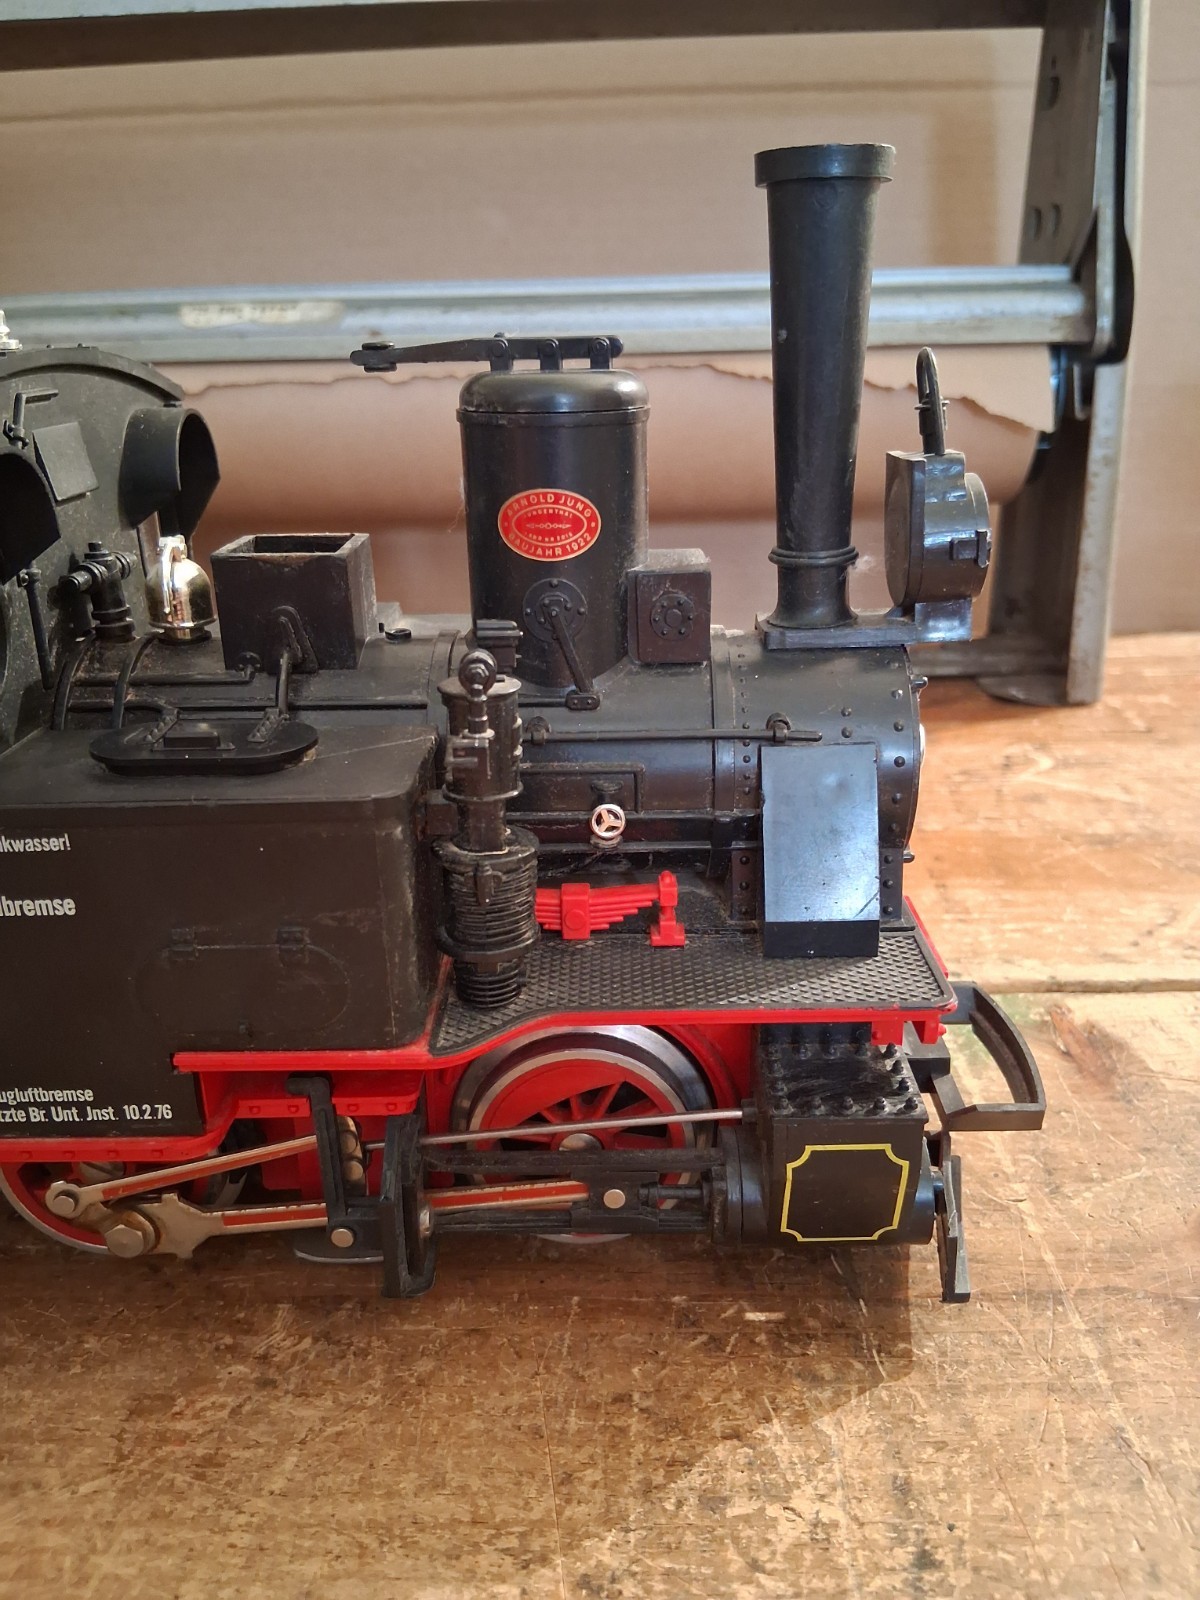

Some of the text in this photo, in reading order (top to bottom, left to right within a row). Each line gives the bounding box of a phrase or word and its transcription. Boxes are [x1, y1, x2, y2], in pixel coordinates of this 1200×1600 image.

[506, 494, 592, 518] ARNOLD JUNG
[509, 532, 563, 557] BAUJAHR
[566, 532, 592, 553] 1922
[0, 896, 76, 917] bremse
[28, 1106, 49, 1122] Br.
[51, 1106, 83, 1122] Unt.
[123, 1103, 173, 1120] 10.2.76
